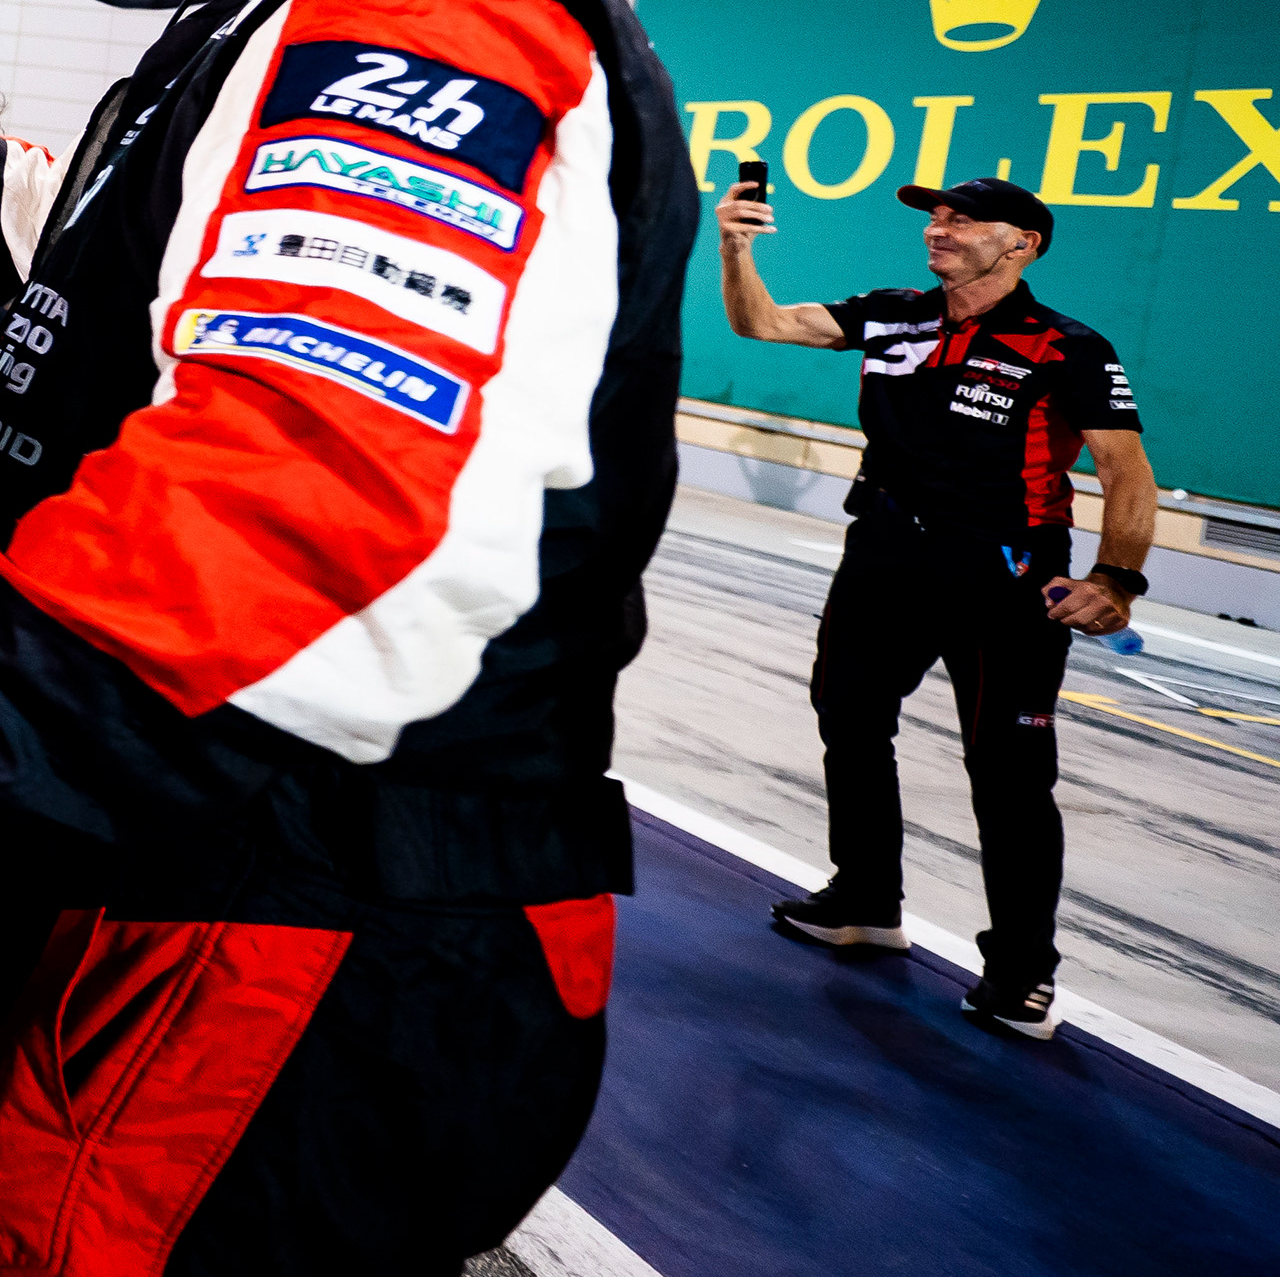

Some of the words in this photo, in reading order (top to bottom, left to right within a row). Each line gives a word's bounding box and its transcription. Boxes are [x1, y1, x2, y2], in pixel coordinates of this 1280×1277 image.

[309, 94, 359, 116] LE
[354, 104, 462, 150] MANS
[261, 148, 503, 229] HAYASHI
[241, 326, 438, 403] MICHELIN
[949, 401, 992, 421] Mobil
[955, 383, 1015, 410] FUJITSU
